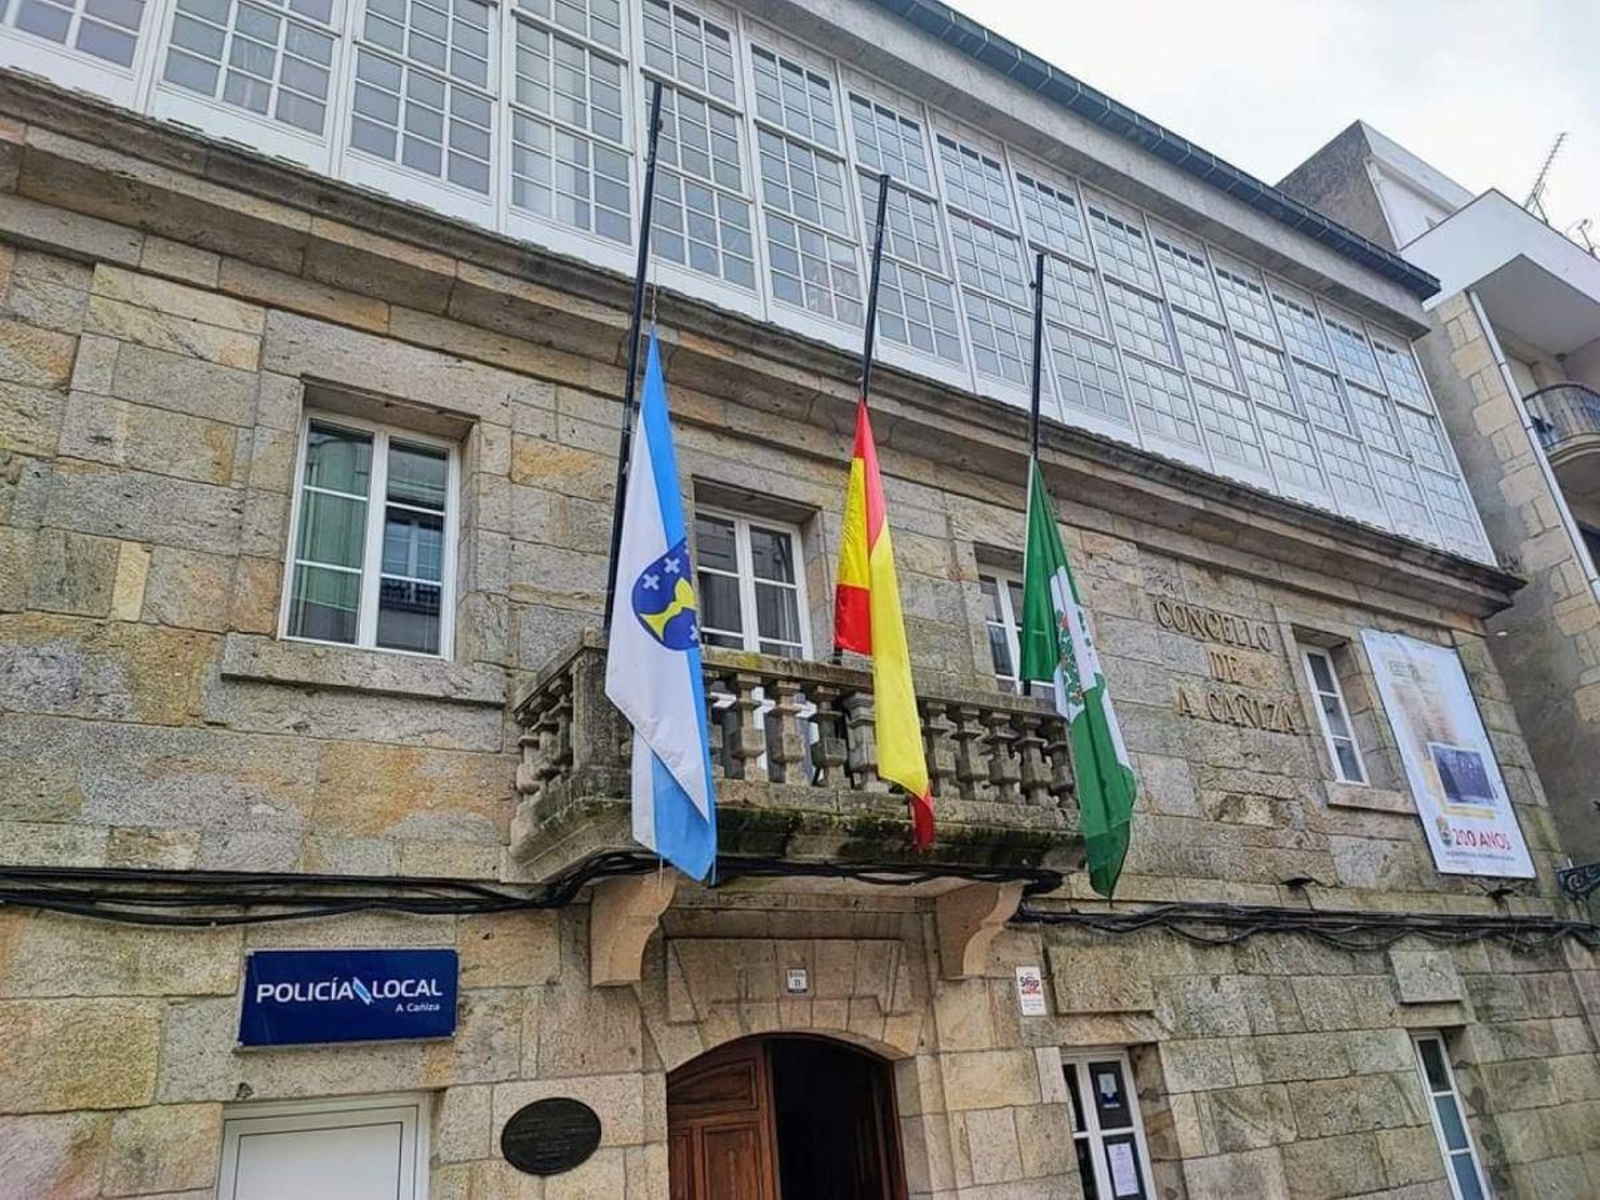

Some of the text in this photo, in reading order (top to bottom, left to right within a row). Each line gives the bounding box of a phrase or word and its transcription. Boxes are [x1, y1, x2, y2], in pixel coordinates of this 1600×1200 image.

[1155, 601, 1271, 652] CONCELLO
[1209, 650, 1242, 684] DE
[1176, 686, 1196, 718] A
[1453, 828, 1477, 846] 200
[257, 977, 443, 1003] POLICÍA LOCAL
[395, 1003, 404, 1013] A
